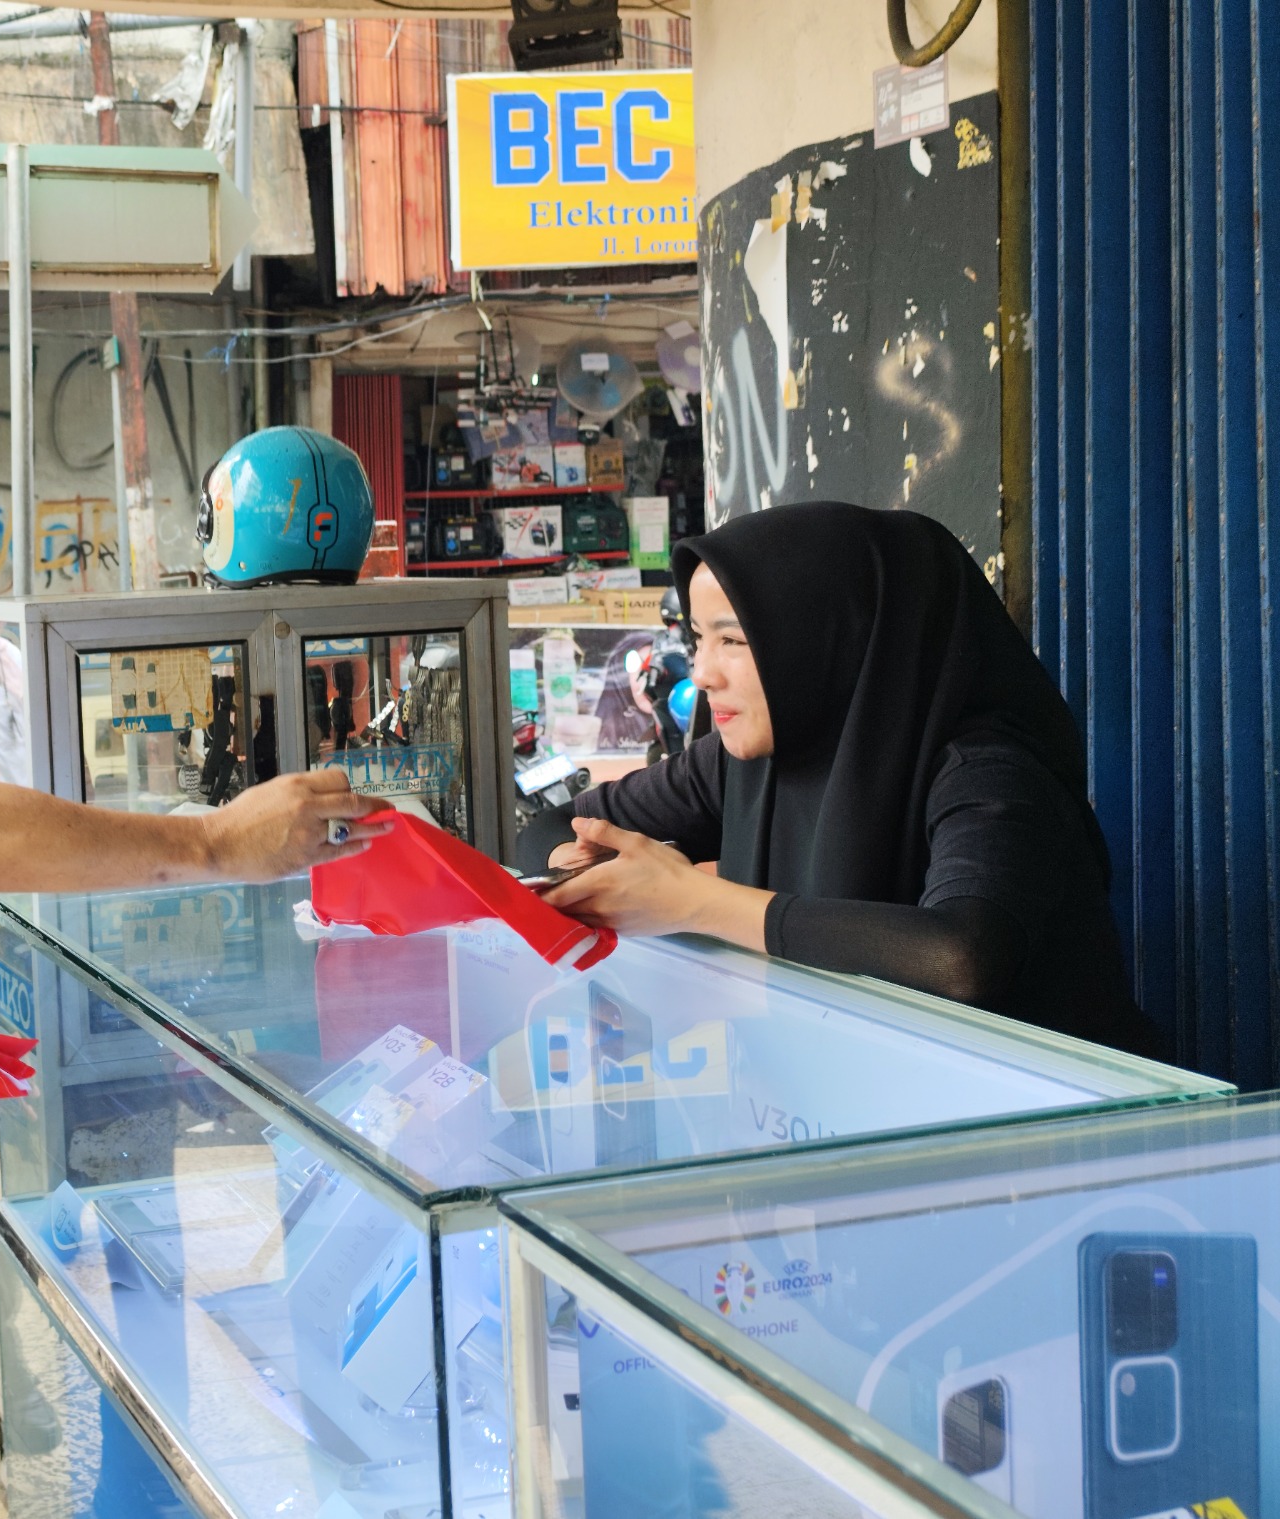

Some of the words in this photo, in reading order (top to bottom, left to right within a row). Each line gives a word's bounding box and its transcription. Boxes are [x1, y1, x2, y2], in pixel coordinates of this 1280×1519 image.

[490, 89, 672, 187] BEC
[599, 238, 625, 256] Jl.
[634, 236, 698, 254] Loron
[380, 1035, 407, 1054] Y03
[427, 1067, 456, 1088] Y28
[613, 1356, 657, 1374] OFFIC
